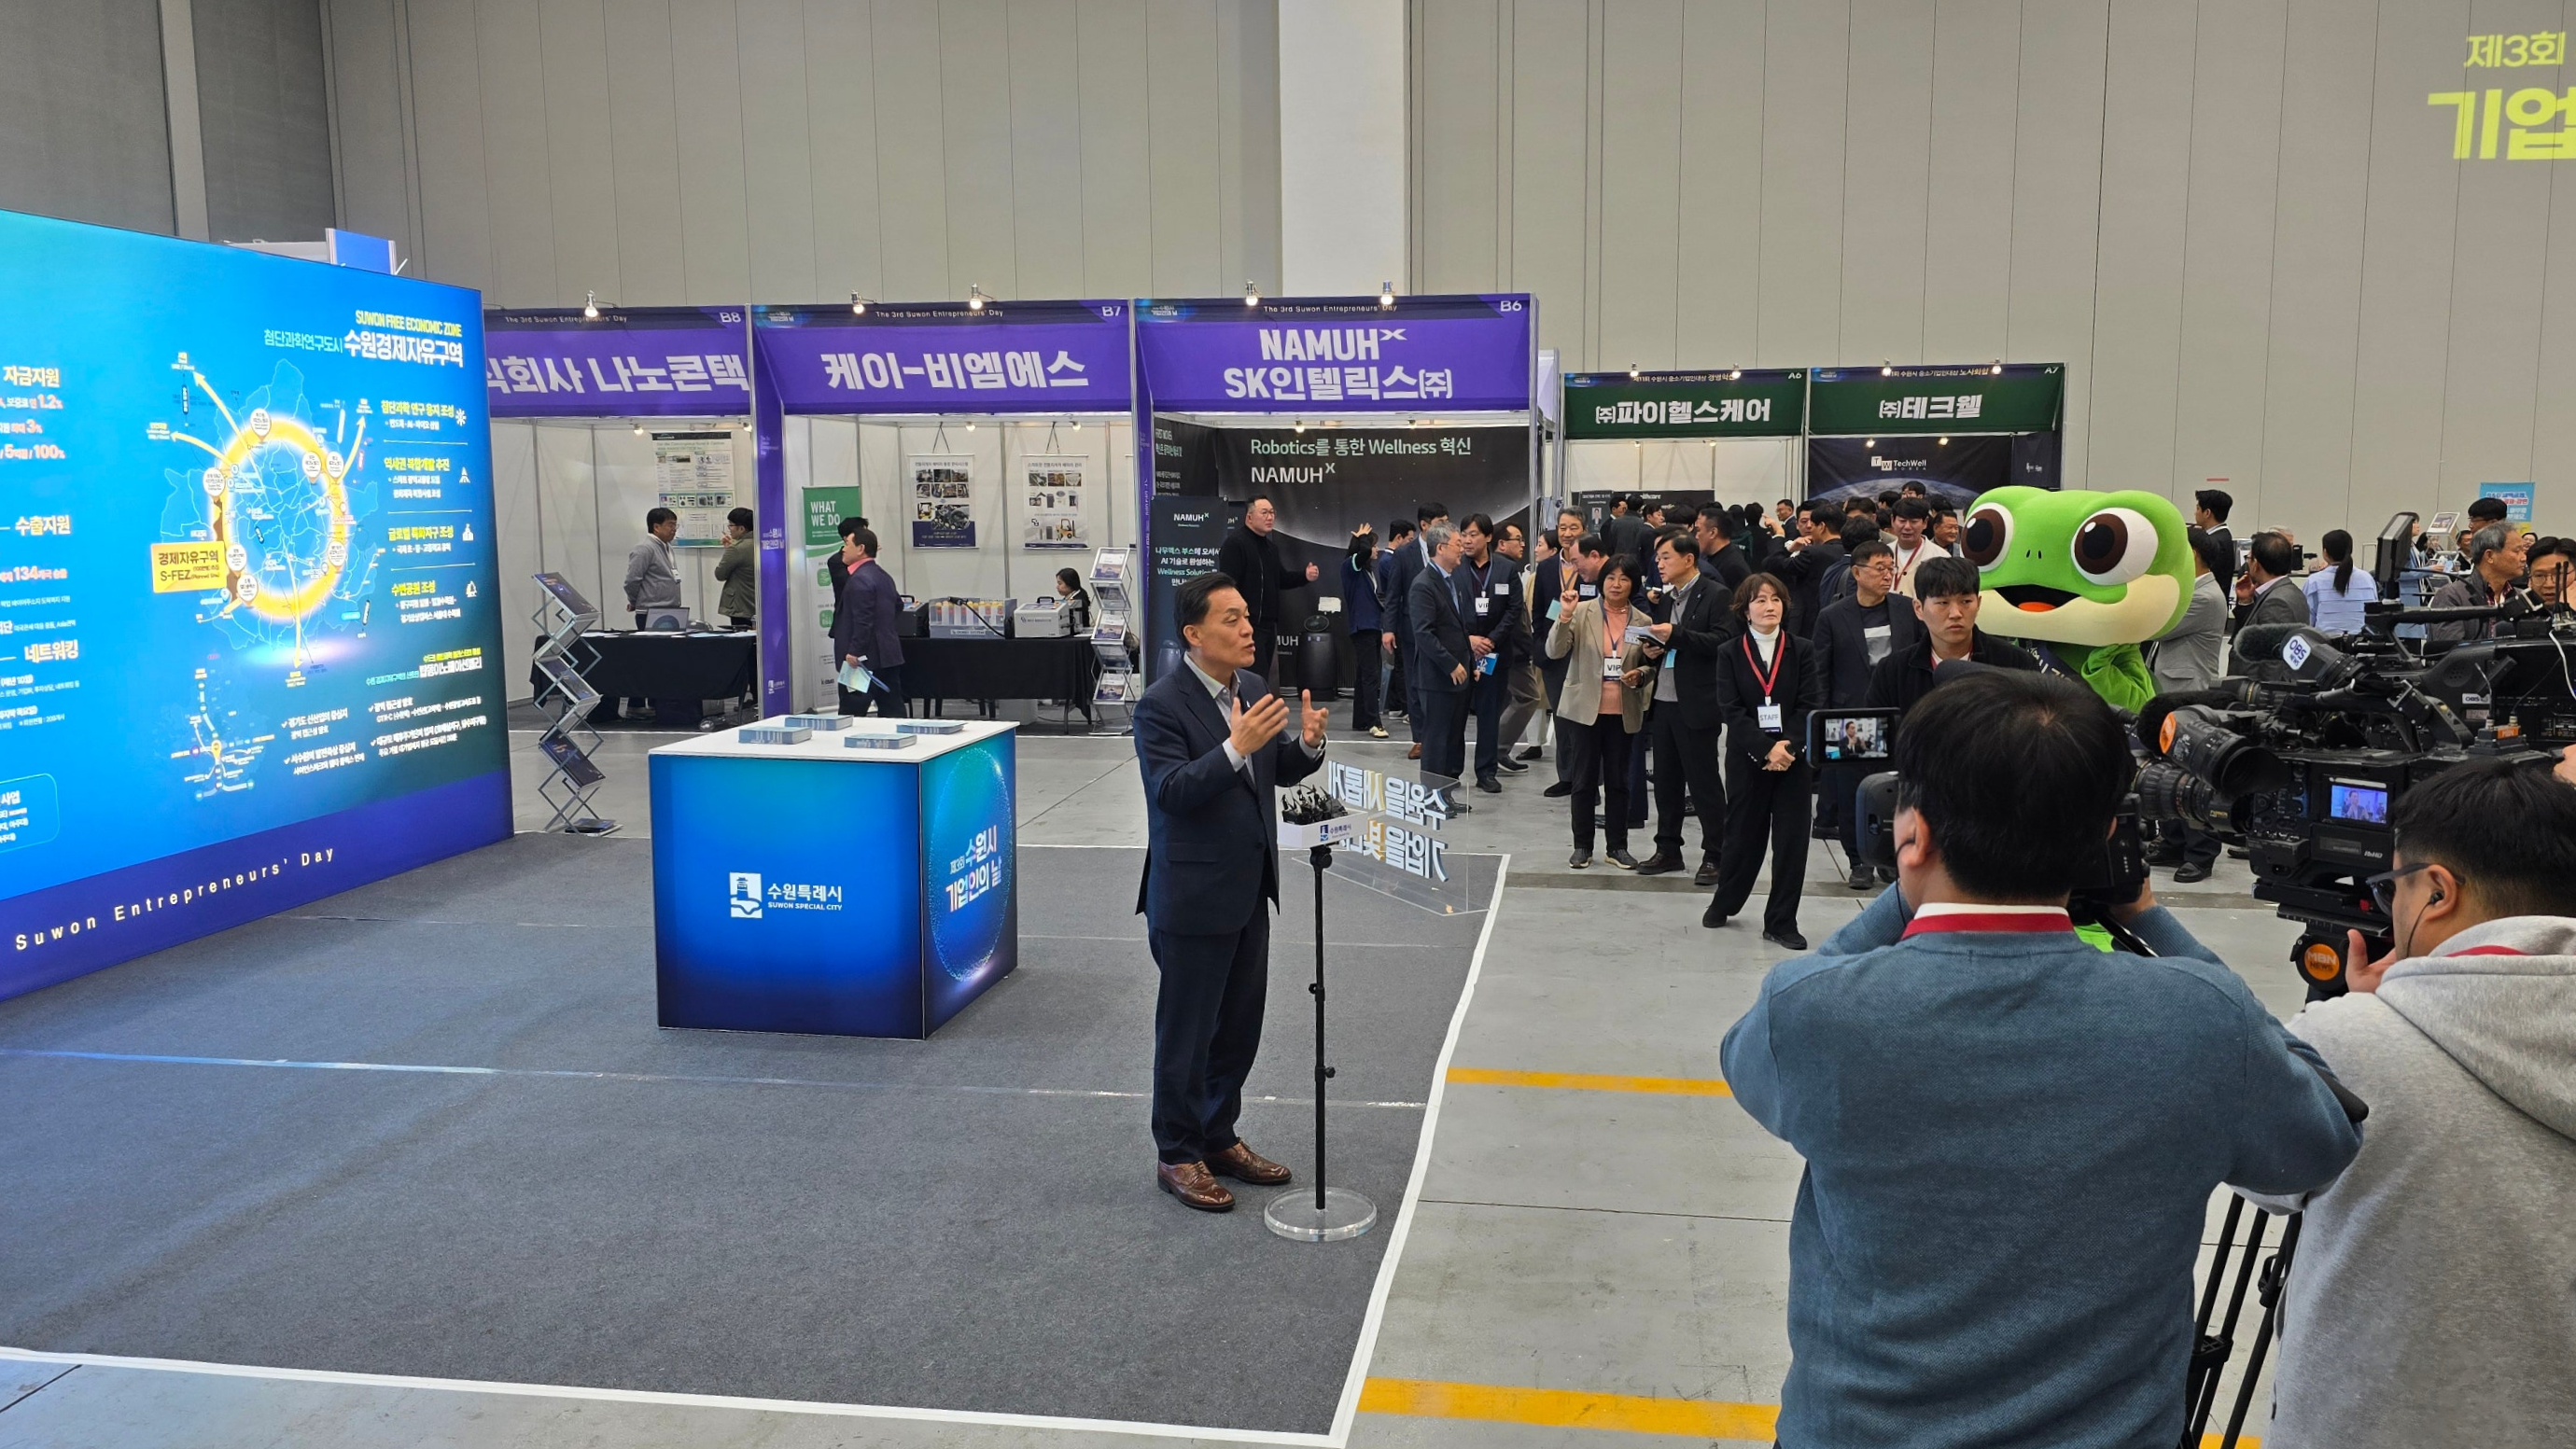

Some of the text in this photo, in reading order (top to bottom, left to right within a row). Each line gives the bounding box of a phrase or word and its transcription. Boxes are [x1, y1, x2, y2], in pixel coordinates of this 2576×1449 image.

[2463, 30, 2567, 68] 제3회
[989, 309, 1003, 317] Day
[1499, 300, 1523, 313] B6
[355, 309, 463, 338] SUWON FREE ECONOMIC ZONE
[535, 315, 558, 324] Suwon
[613, 314, 627, 324] Day
[719, 312, 742, 324] B8
[343, 328, 464, 369] 수원경제자유구역
[3, 365, 61, 388] 자금지원
[820, 350, 1090, 390] 케이-비엠에스
[1787, 371, 1802, 380] A6
[2043, 366, 2060, 375] A7
[1225, 367, 1453, 401] SK인텔릭스(주)
[1595, 397, 1771, 425] (주)파이헬스케어
[1879, 394, 1983, 420] (주)테크웰
[1251, 437, 1472, 457] Robotics를 통한 Wellness 혁신
[1893, 459, 1927, 467] TechWell
[810, 500, 837, 514] WHAT
[15, 514, 72, 536] 수출지원
[811, 513, 841, 527] WE DO
[159, 550, 219, 565] 경제자유구역
[161, 569, 191, 581] S-FEZ
[1157, 567, 1185, 576] Wellness
[24, 639, 79, 663] 네트워킹
[2289, 639, 2307, 660] OBS
[1606, 663, 1621, 672] VIP
[1759, 713, 1779, 722] STAFF
[965, 824, 998, 868] 수원시
[945, 855, 1002, 913] 기업인의 날
[15, 915, 96, 952] Suwon
[301, 846, 334, 867] Day
[767, 883, 842, 903] 수원특례시
[767, 901, 794, 910] SUWON
[795, 902, 826, 911] SPECIAL
[2306, 951, 2337, 966] MBN
